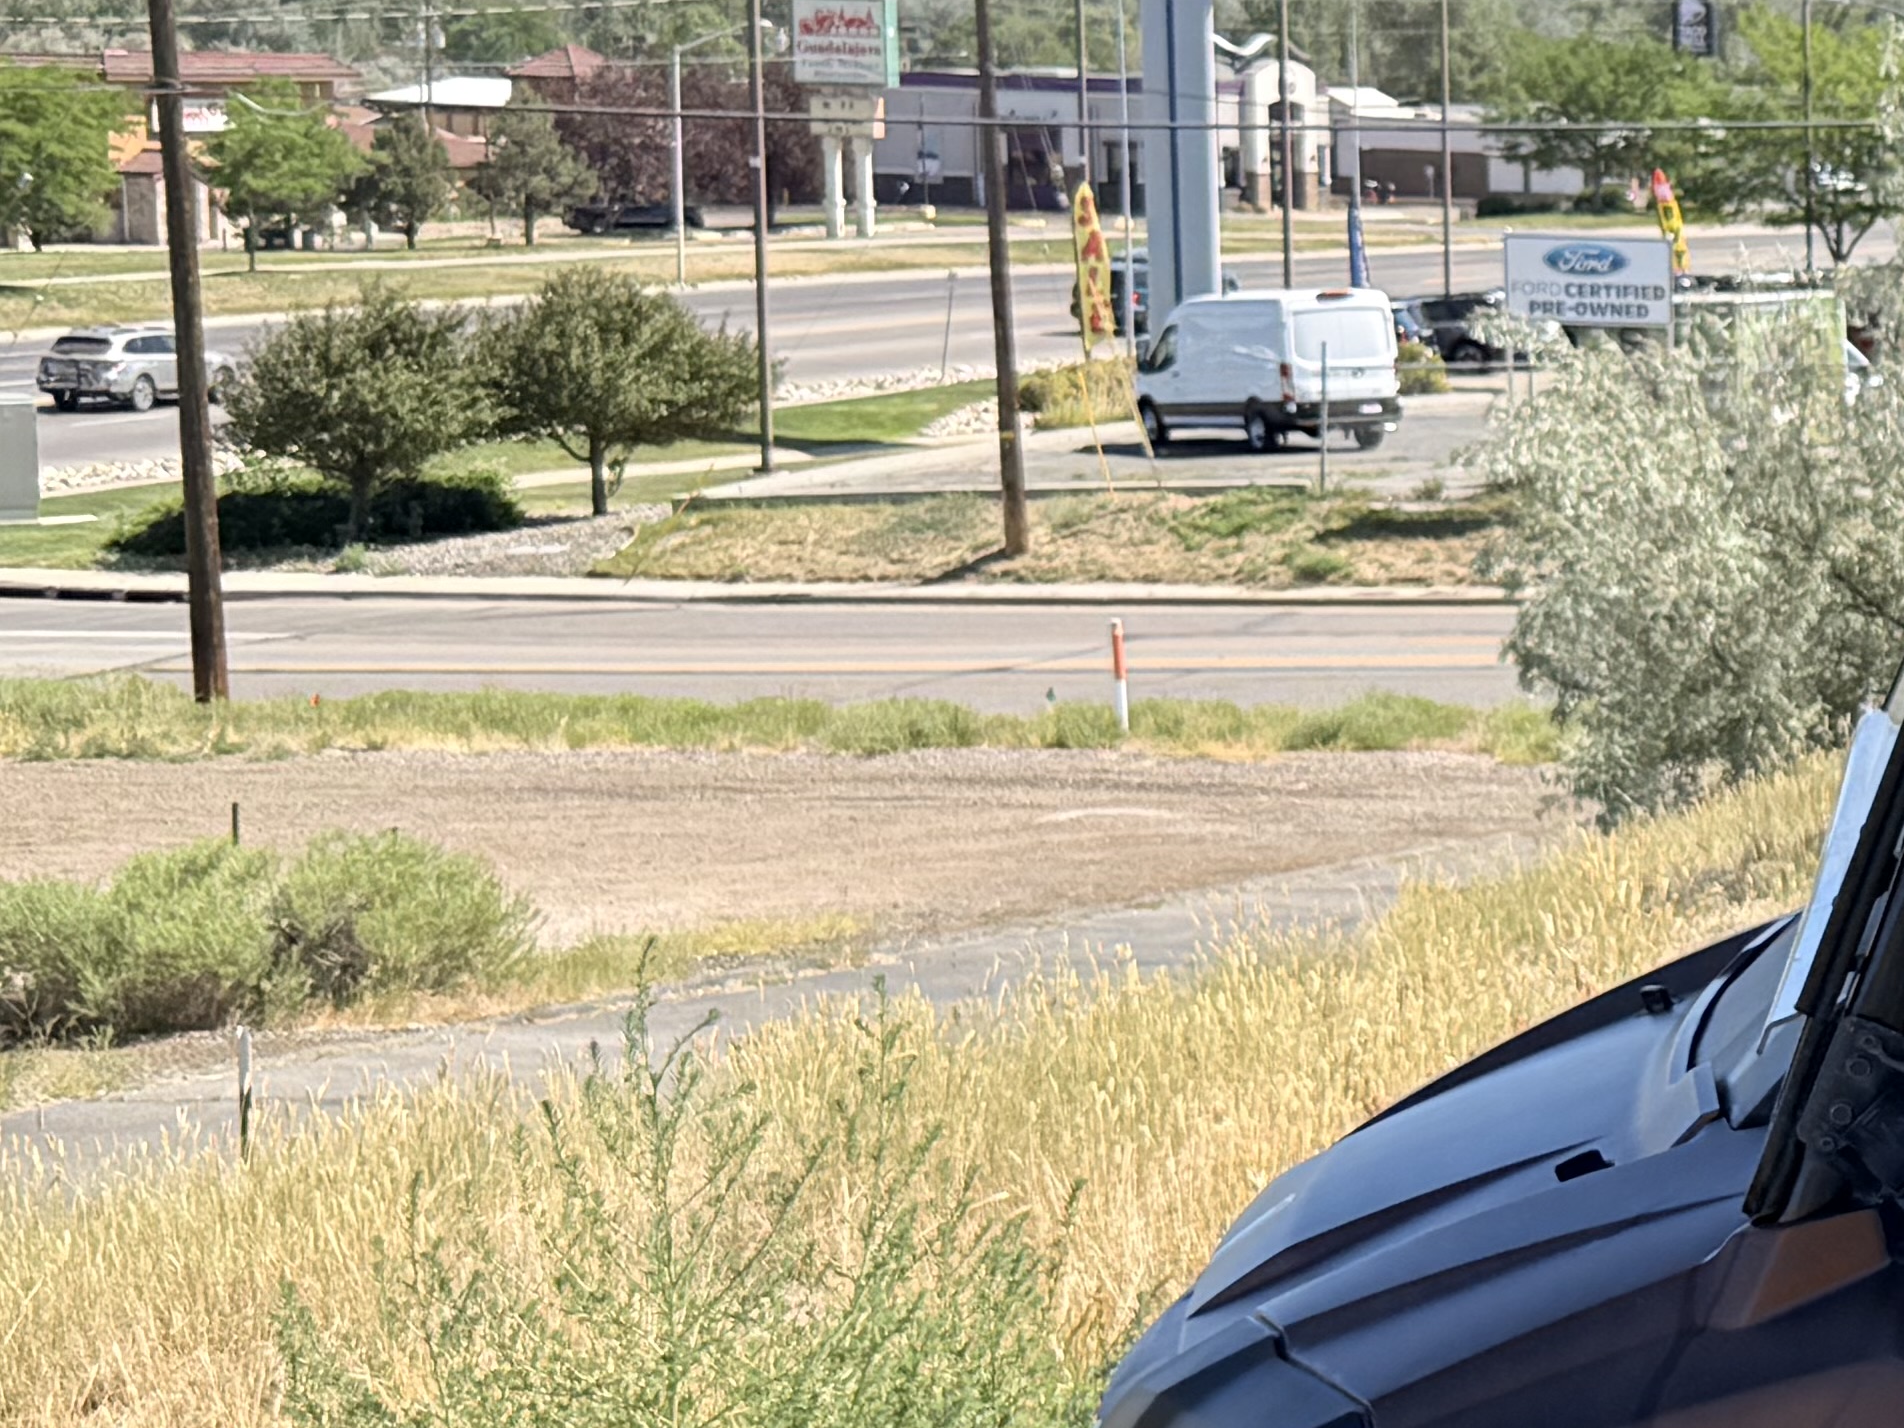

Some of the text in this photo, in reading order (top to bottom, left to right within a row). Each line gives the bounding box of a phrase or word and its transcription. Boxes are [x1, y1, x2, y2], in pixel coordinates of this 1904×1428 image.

[1557, 248, 1614, 272] Ford
[1511, 280, 1666, 302] FORD CERTIFIED
[1528, 299, 1650, 319] PRE-OWNED
